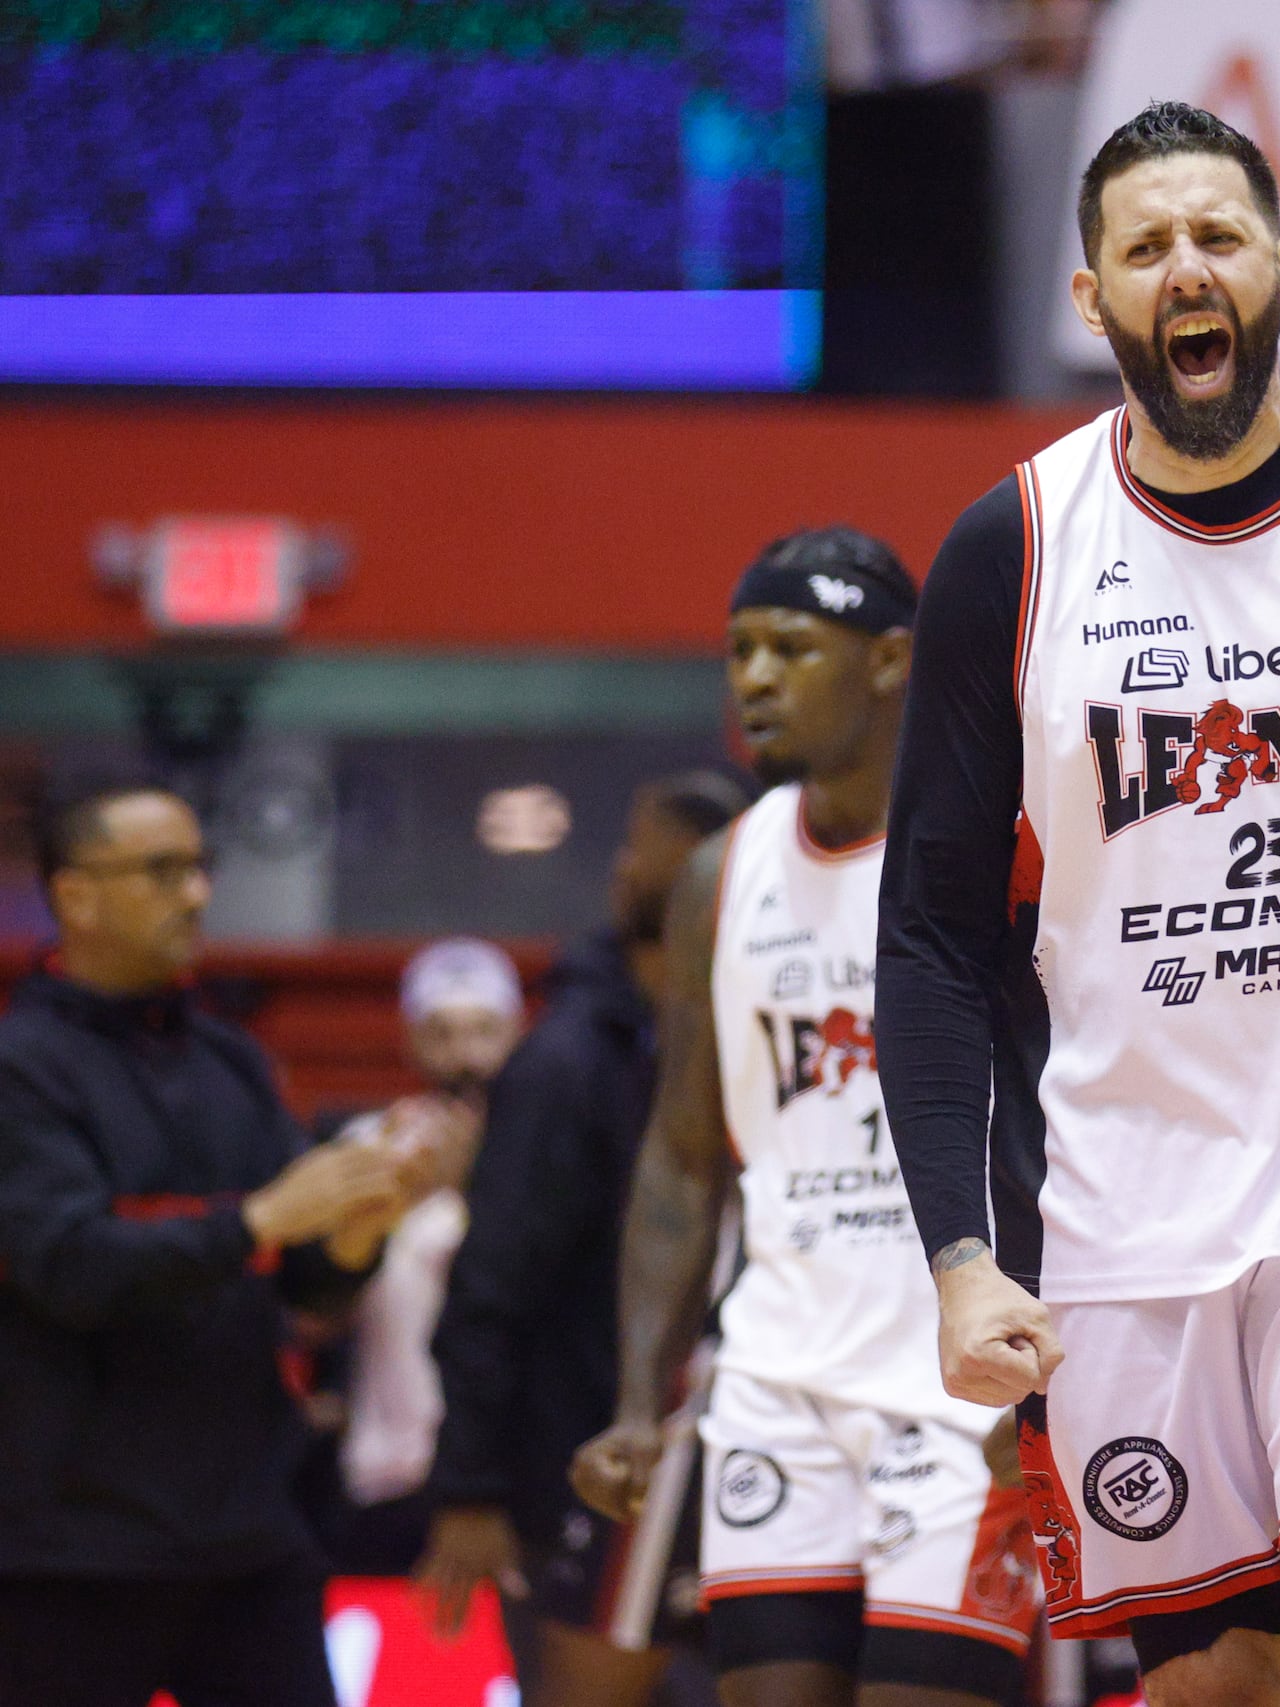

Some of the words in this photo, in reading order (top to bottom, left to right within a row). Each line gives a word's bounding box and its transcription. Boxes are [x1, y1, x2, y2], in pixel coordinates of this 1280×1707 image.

[1096, 560, 1130, 590] AC
[1087, 1449, 1113, 1497] FURNITURE
[1123, 1440, 1174, 1469] APPLIANCES
[1108, 1465, 1159, 1508] RAC
[1155, 1475, 1184, 1533] ELECTRONICS
[1093, 1506, 1145, 1537] COMPUTERS
